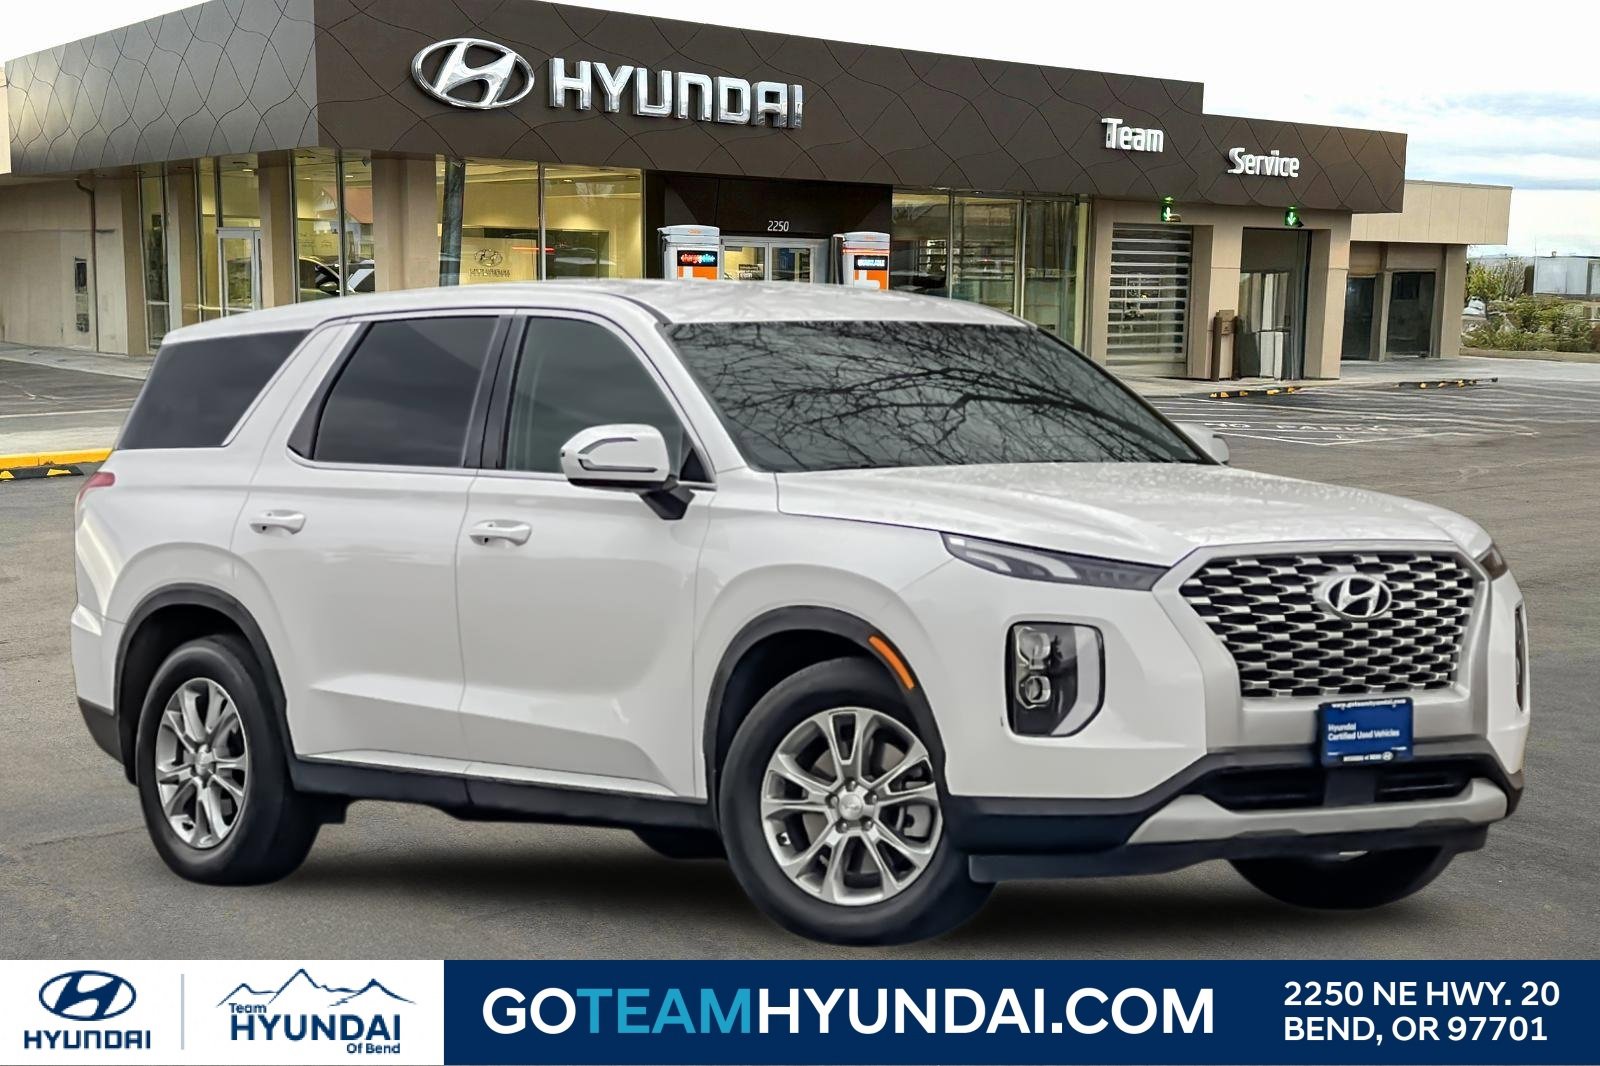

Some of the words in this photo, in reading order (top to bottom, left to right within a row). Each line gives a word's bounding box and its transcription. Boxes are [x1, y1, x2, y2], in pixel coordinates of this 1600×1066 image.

[549, 57, 804, 127] HYUNDAI
[1101, 117, 1164, 152] Team
[1227, 147, 1300, 177] Service
[767, 220, 790, 232] 2250
[1327, 723, 1357, 732] Hyundai
[1327, 731, 1357, 741] Certified
[1356, 730, 1374, 740] Used
[1374, 729, 1400, 738] Vehicles
